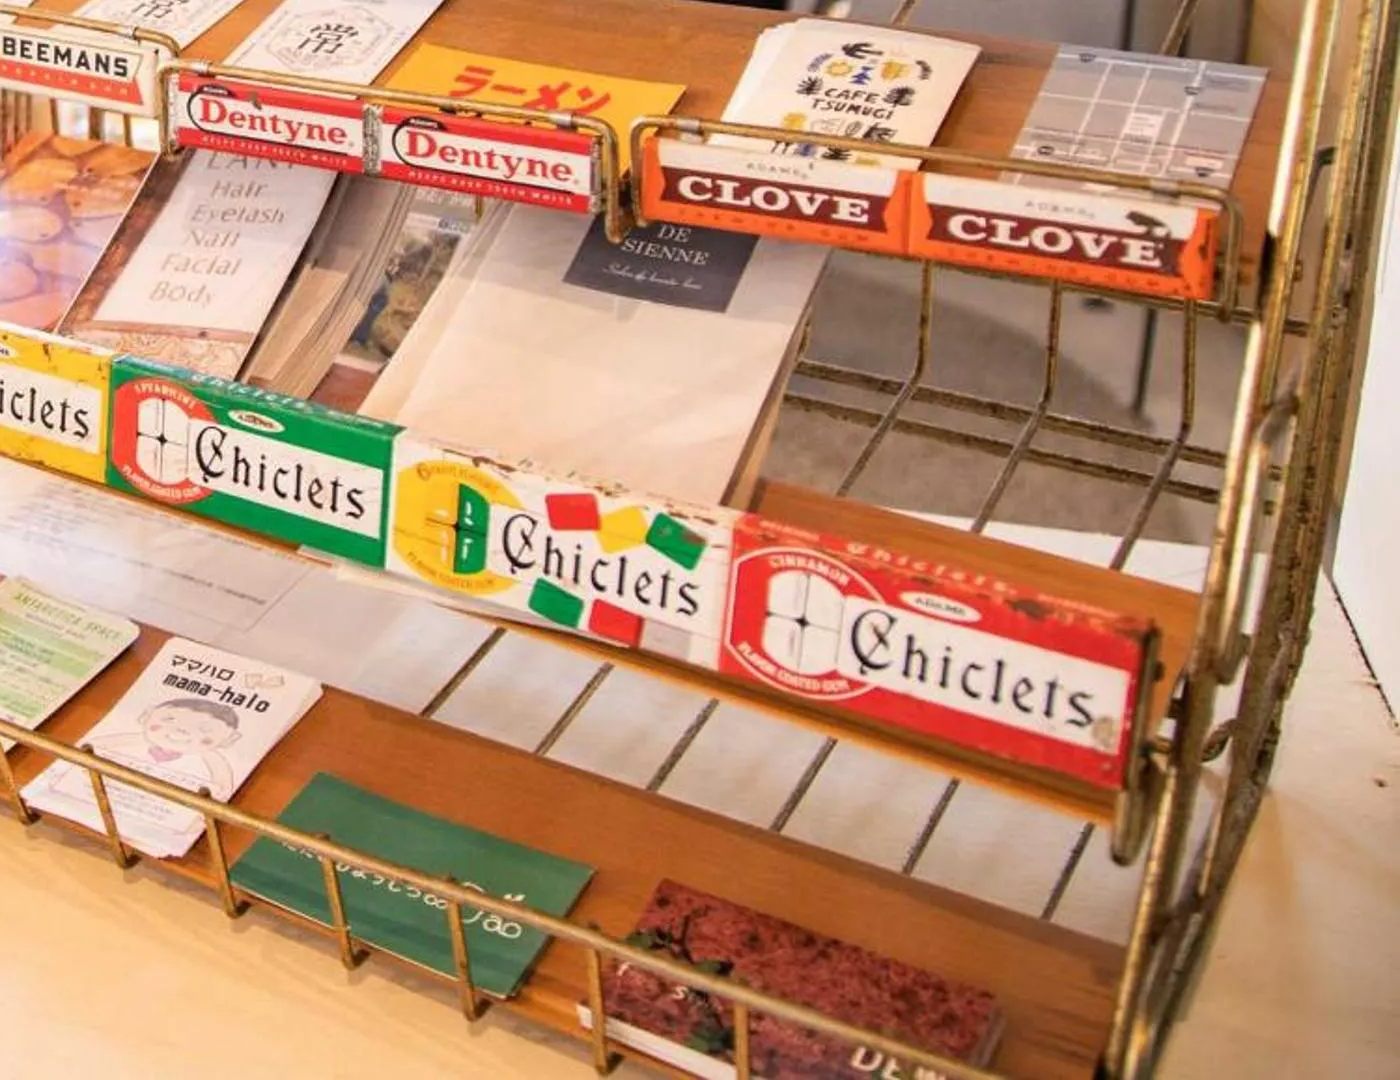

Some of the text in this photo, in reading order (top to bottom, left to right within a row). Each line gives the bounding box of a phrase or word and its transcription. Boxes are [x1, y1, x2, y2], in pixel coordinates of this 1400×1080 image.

[3, 36, 129, 77] BEEMANS
[449, 65, 611, 115] ラーメン
[824, 88, 881, 104] CAFE
[199, 98, 348, 144] Dentyne
[811, 98, 895, 120] TSUMUGI
[405, 130, 573, 182] Dentyne
[211, 179, 268, 200] Hair
[678, 175, 870, 224] CLOVE
[192, 204, 287, 224] Eyelash
[183, 230, 240, 247] Nail
[657, 224, 693, 243] DE
[948, 215, 1162, 267] CLOVE
[160, 253, 242, 276] Facial
[620, 238, 711, 266] SIENNE
[195, 425, 366, 520] Chiclets
[503, 513, 700, 617] Chiclets
[770, 555, 850, 586] CINNAMON
[171, 654, 236, 682] ママハロ
[851, 609, 1095, 728] Chiclets
[163, 673, 271, 713] mama-halo
